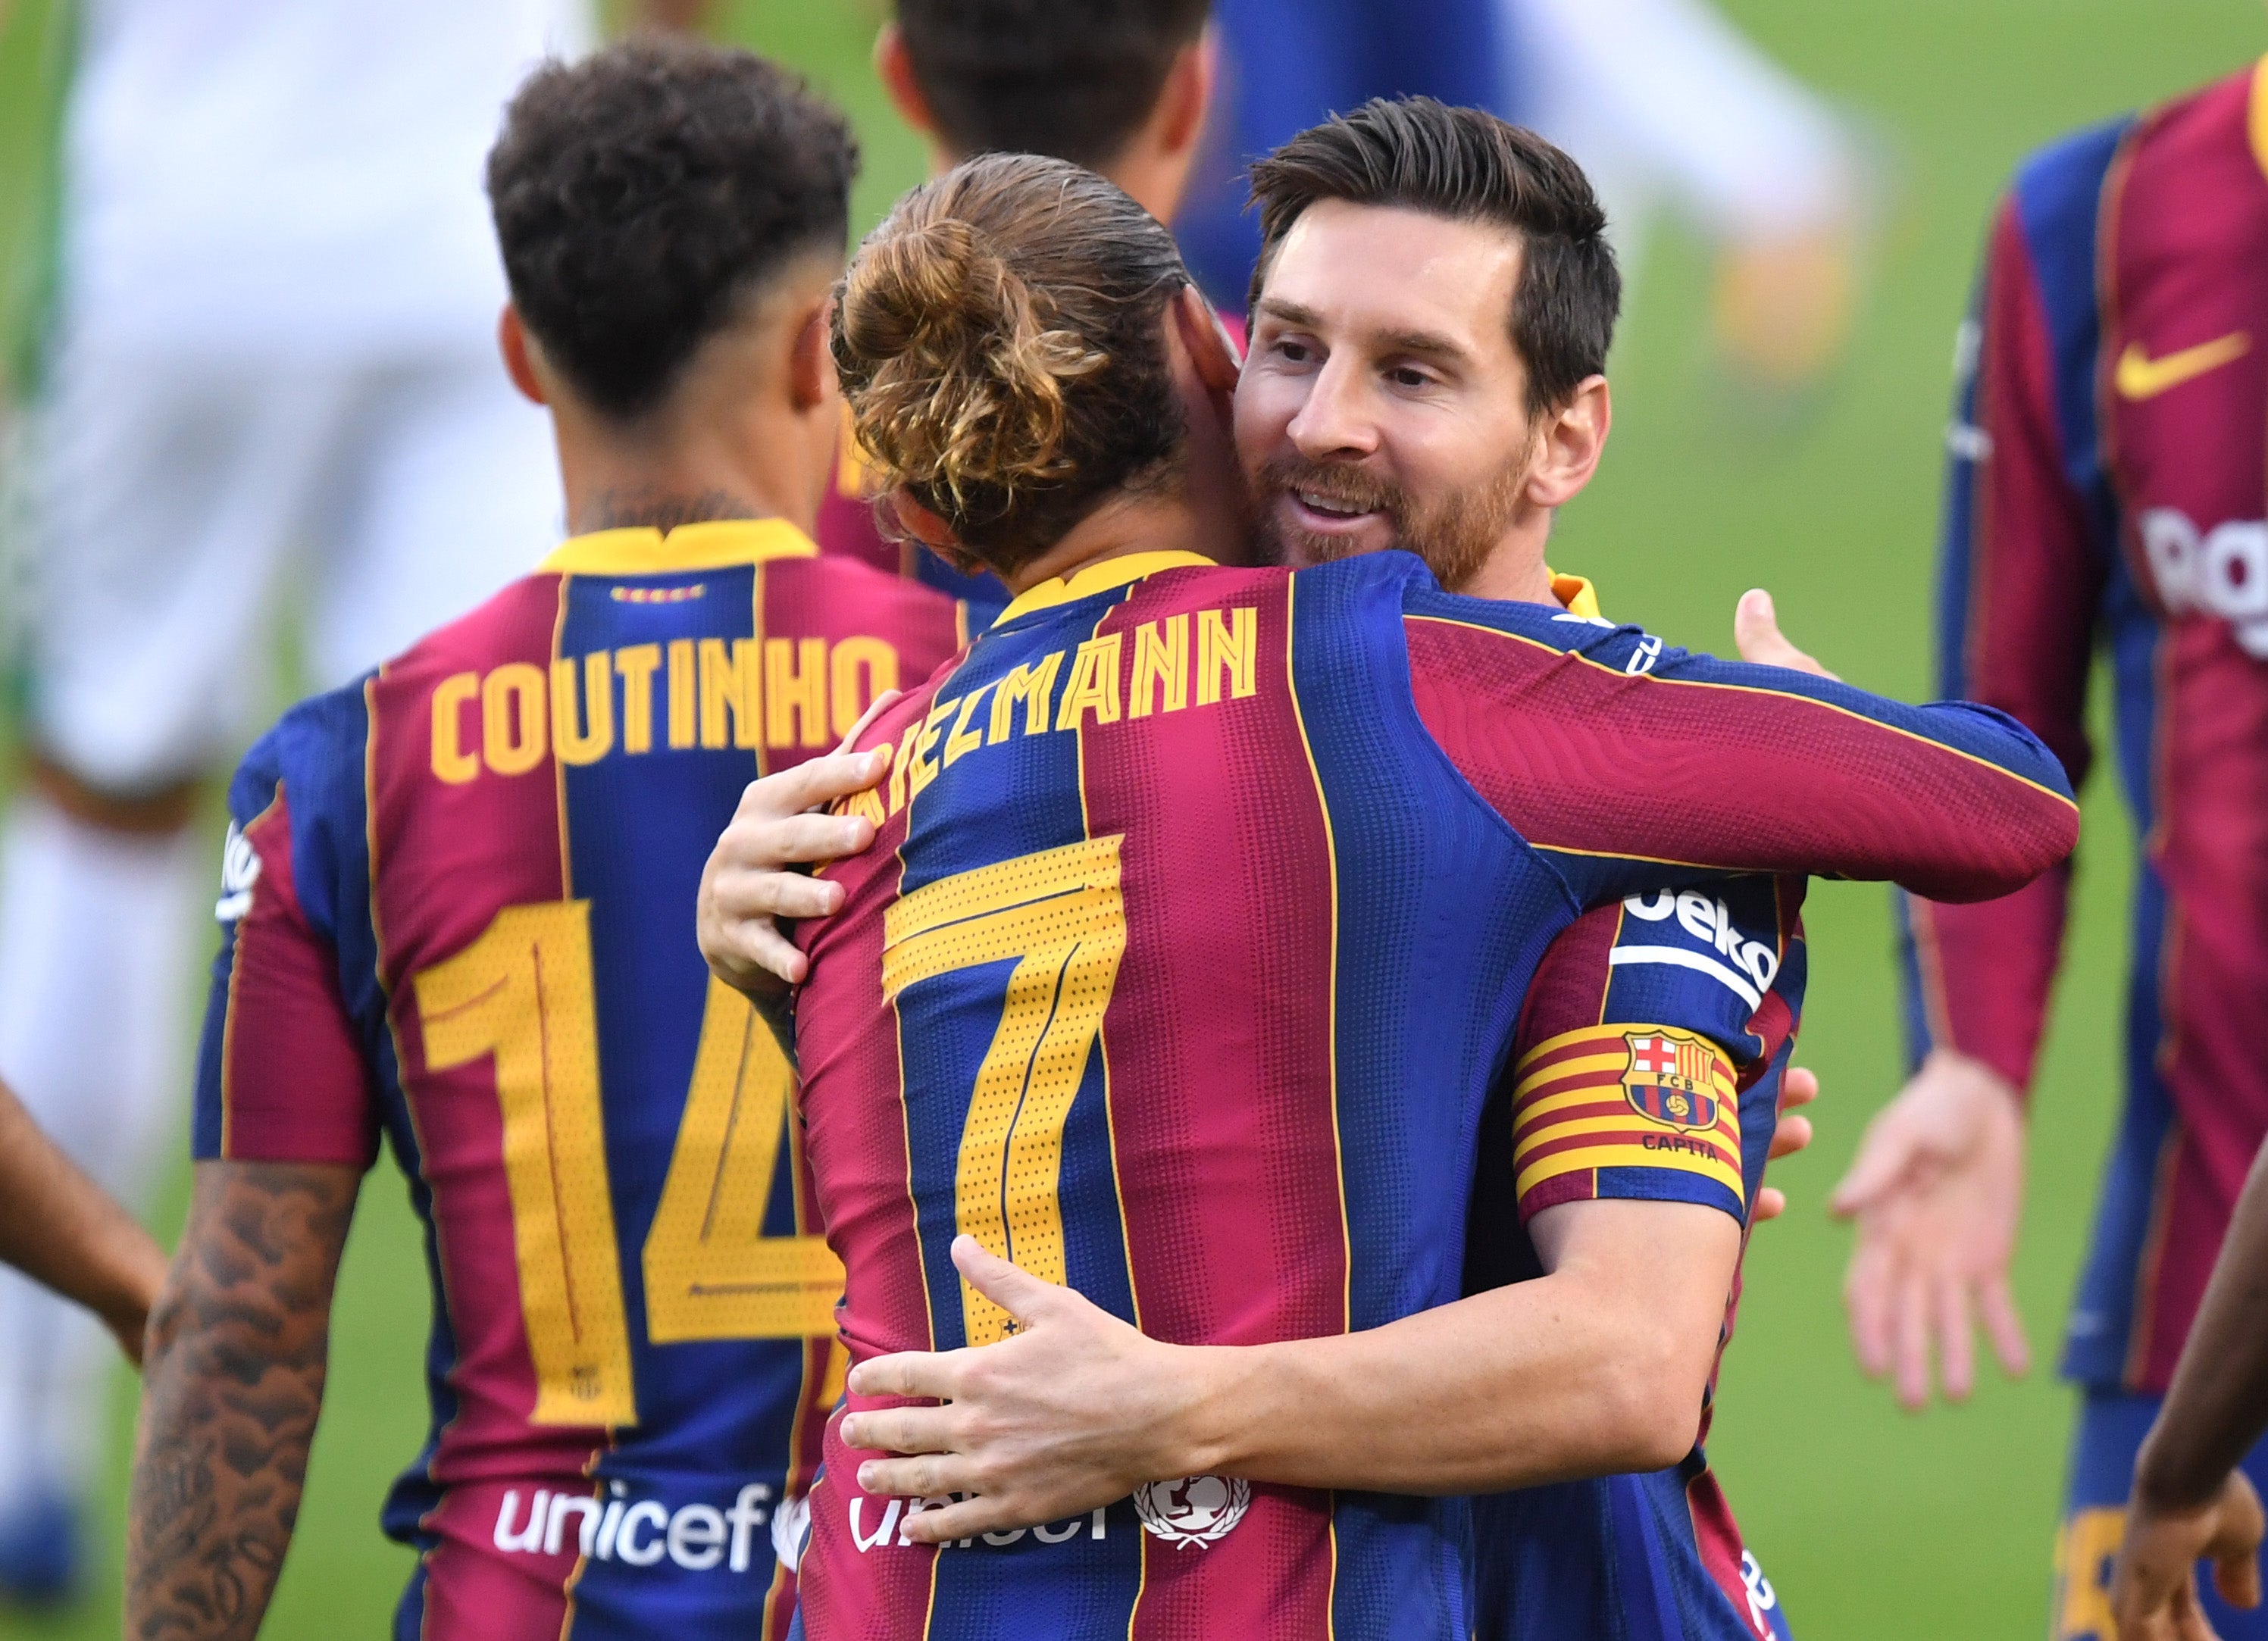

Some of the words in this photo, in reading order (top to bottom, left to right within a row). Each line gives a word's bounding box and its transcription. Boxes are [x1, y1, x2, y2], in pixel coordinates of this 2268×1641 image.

[430, 636, 899, 785] COUTINHO
[812, 607, 1258, 877] RIEZMANN
[413, 899, 849, 1427] 14
[881, 833, 1127, 1352] 7
[493, 1483, 771, 1573] unicef
